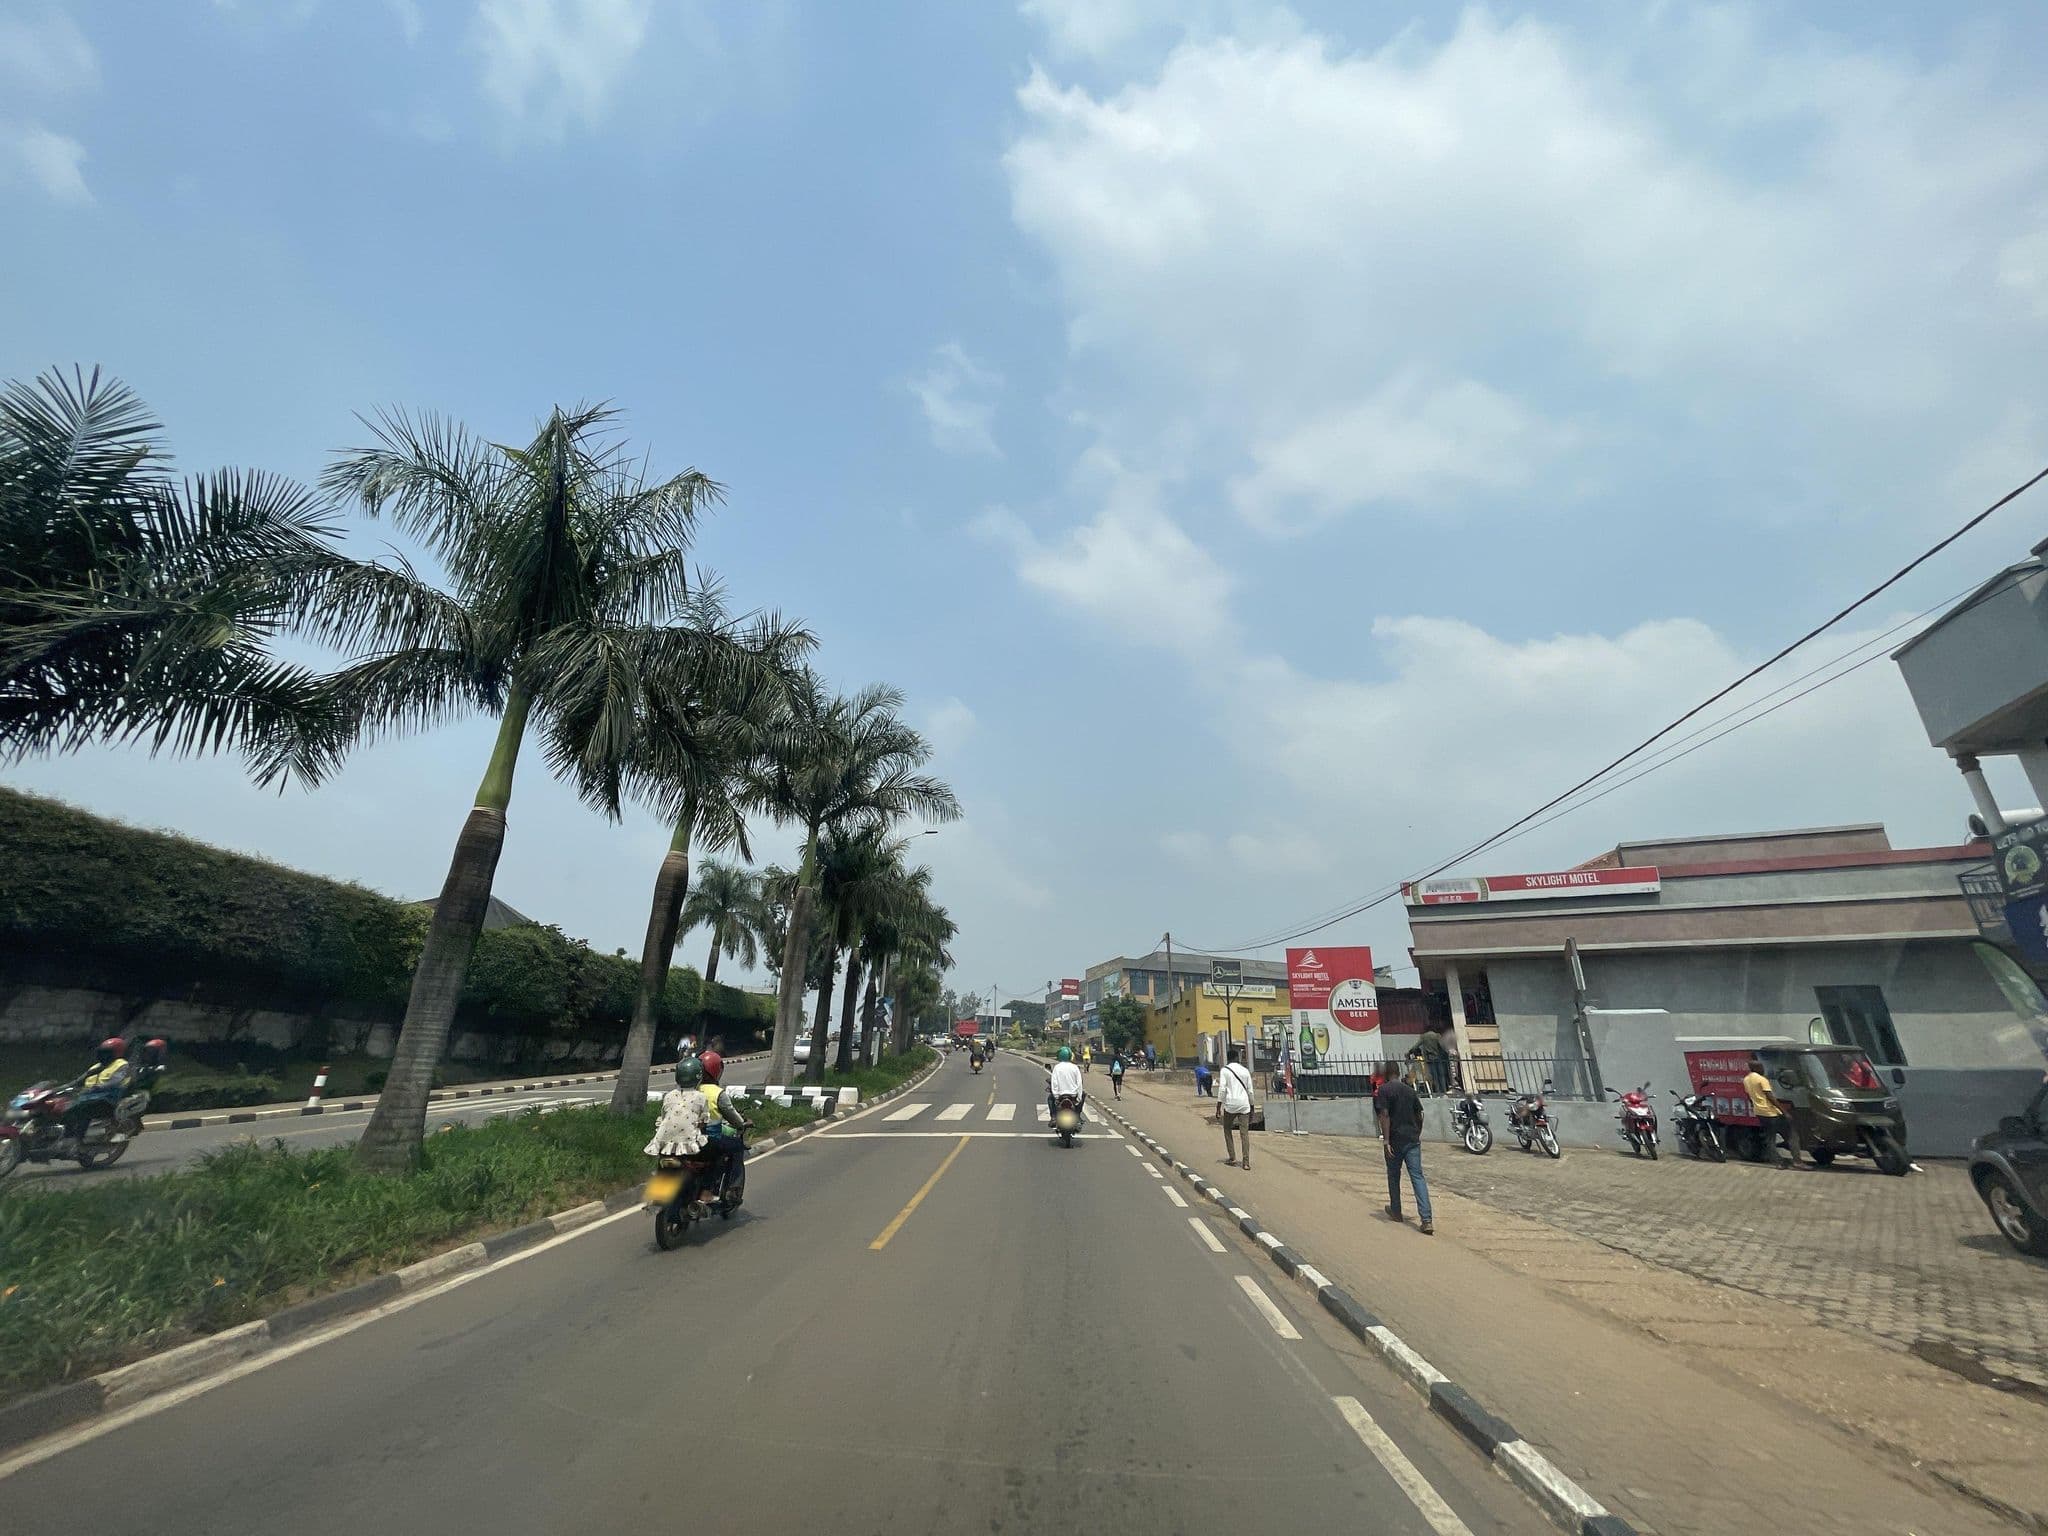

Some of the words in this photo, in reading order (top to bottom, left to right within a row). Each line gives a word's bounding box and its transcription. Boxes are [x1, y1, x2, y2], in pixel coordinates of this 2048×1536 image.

[1525, 874, 1568, 887] SKYLIGHT
[1569, 872, 1600, 884] MOTEL
[1337, 998, 1378, 1008] AMSTEL
